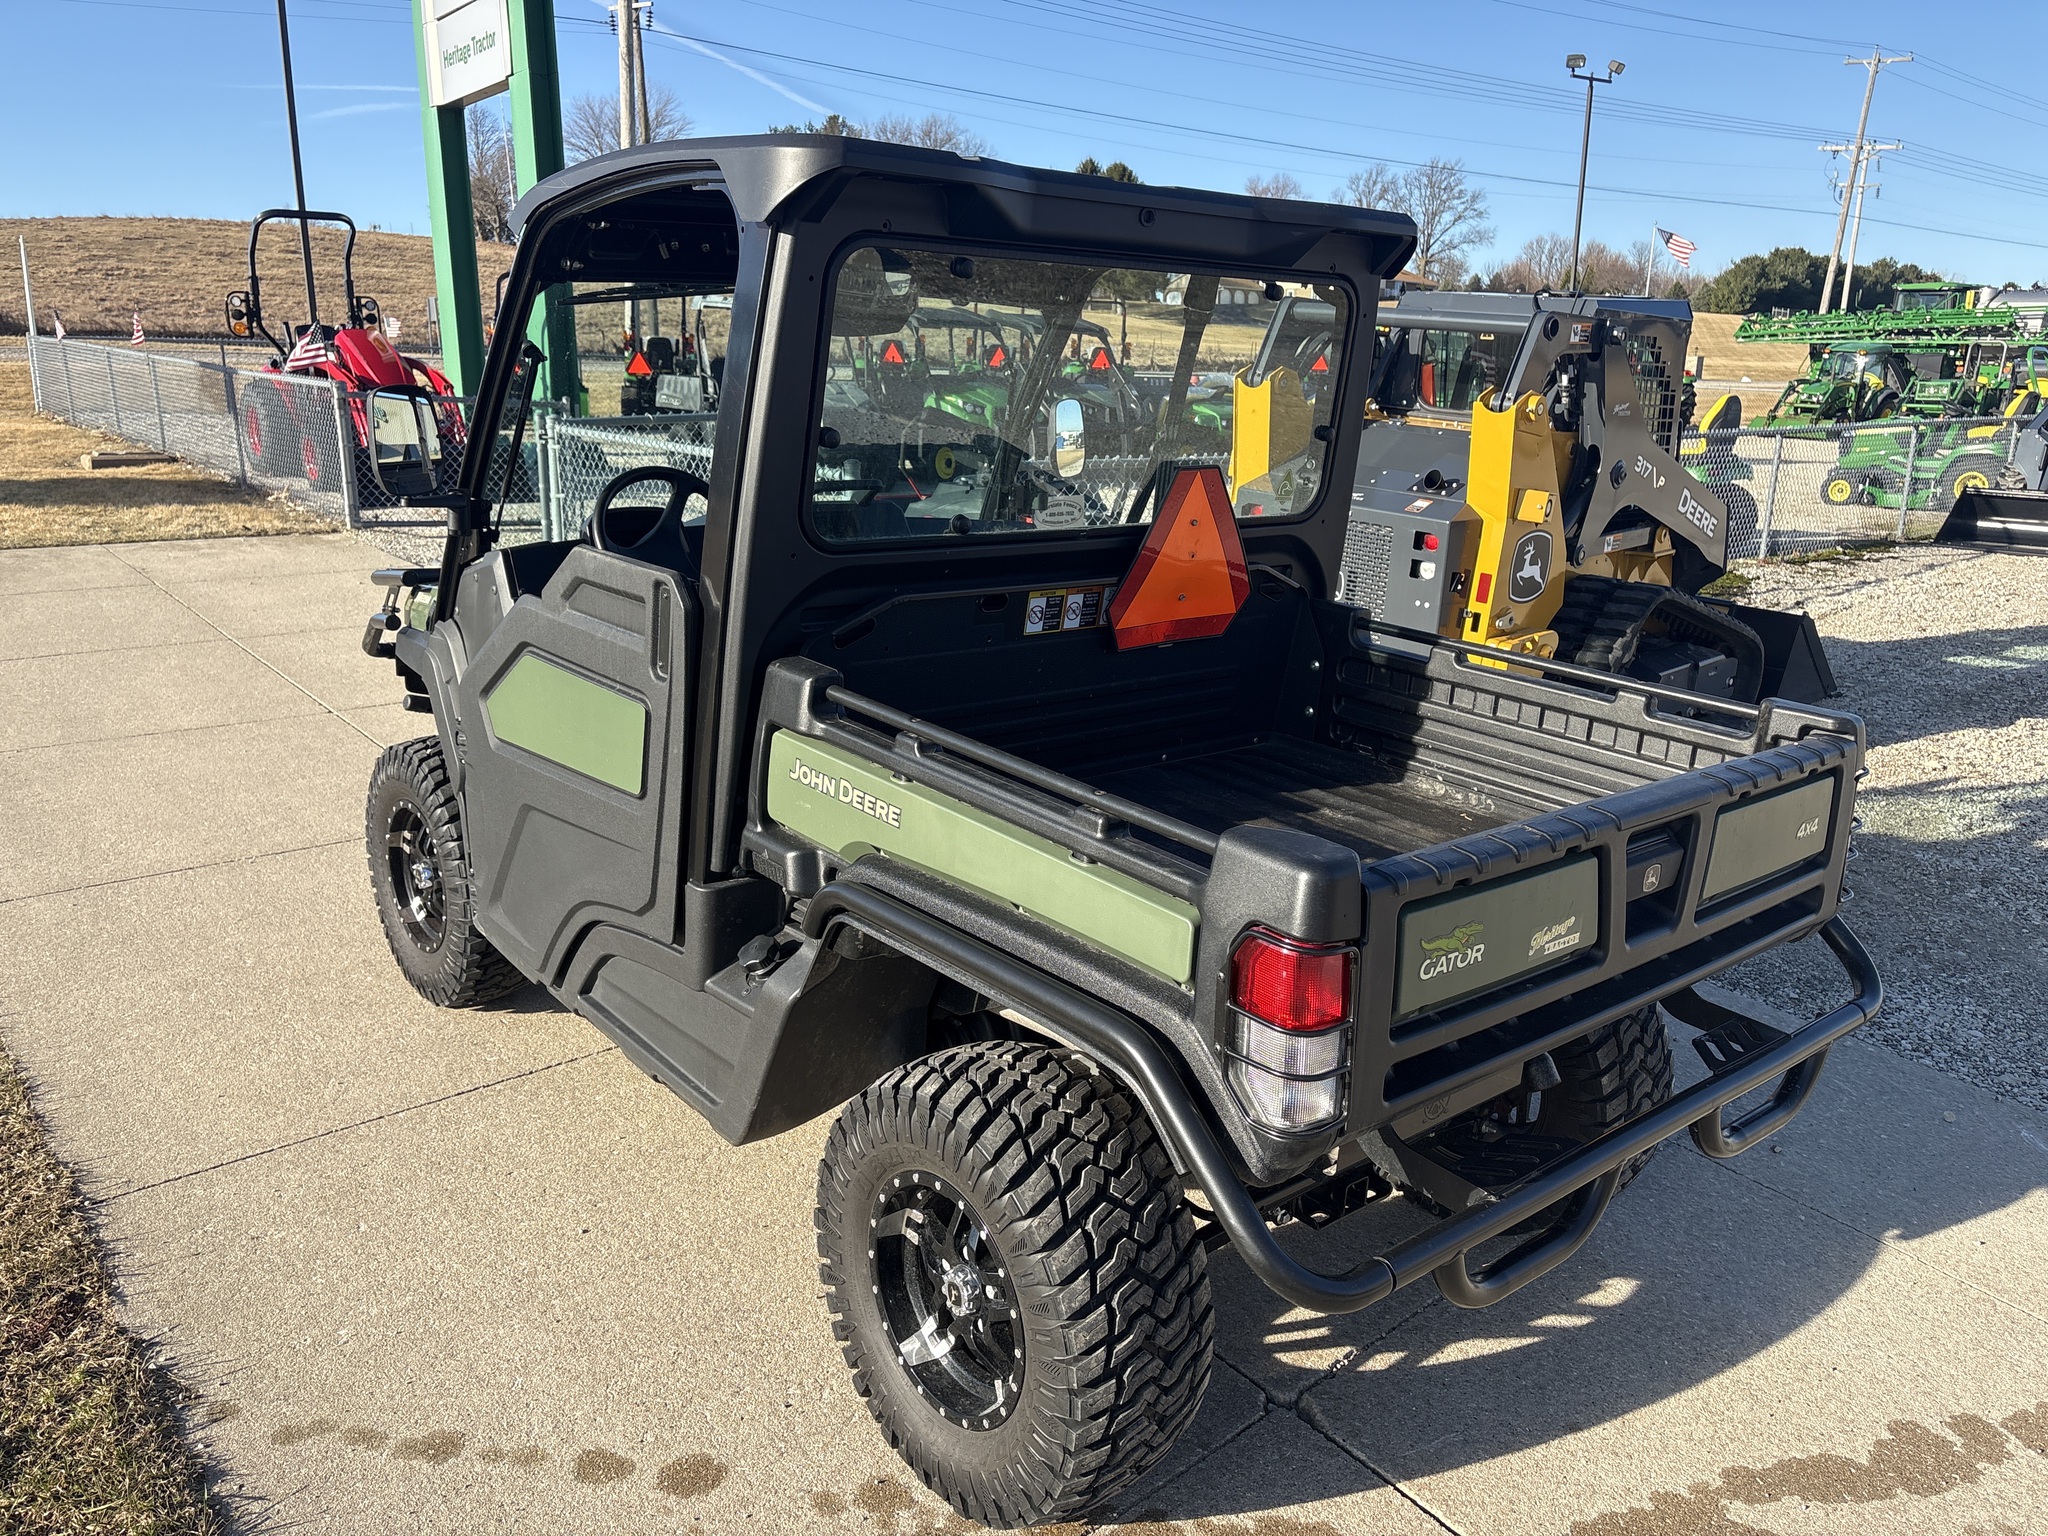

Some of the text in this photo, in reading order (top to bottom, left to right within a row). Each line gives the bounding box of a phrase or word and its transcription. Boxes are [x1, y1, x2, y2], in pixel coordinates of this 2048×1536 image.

[442, 30, 496, 69] Heritage Tractor
[1634, 455, 1653, 478] 317
[1063, 501, 1078, 510] Fence
[1677, 487, 1718, 538] DEERE
[789, 757, 902, 830] JOHN DEERE
[1528, 916, 1576, 956] Heritage
[1543, 932, 1581, 955] TRACTOR
[1419, 943, 1486, 981] GATOR
